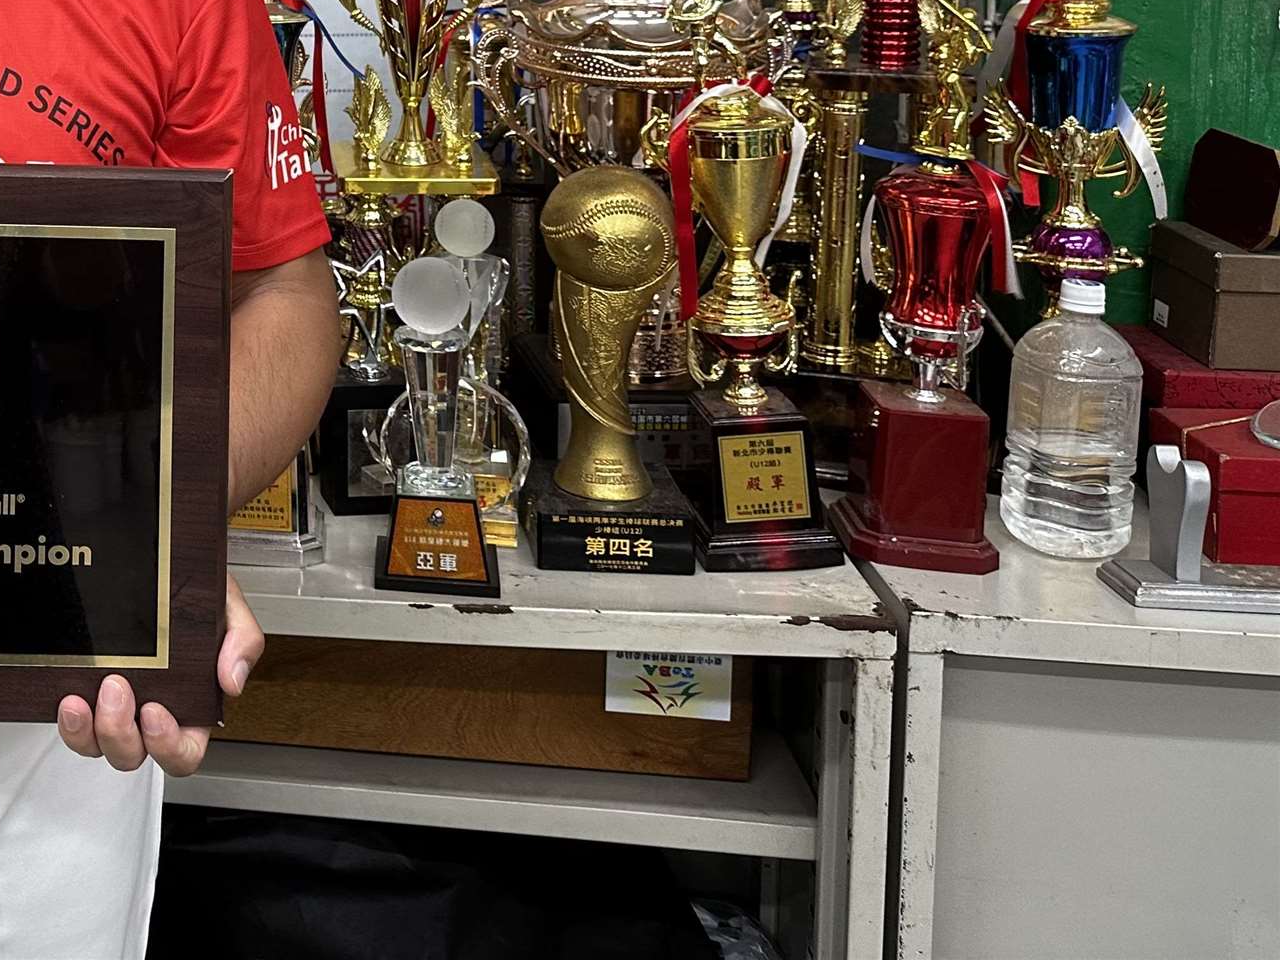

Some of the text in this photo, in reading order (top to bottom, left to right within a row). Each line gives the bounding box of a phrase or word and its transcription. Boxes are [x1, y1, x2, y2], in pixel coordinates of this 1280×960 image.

[27, 84, 125, 166] SERIES
[746, 474, 786, 492] 殿軍
[584, 536, 655, 558] 第四名
[416, 551, 459, 572] 亞軍
